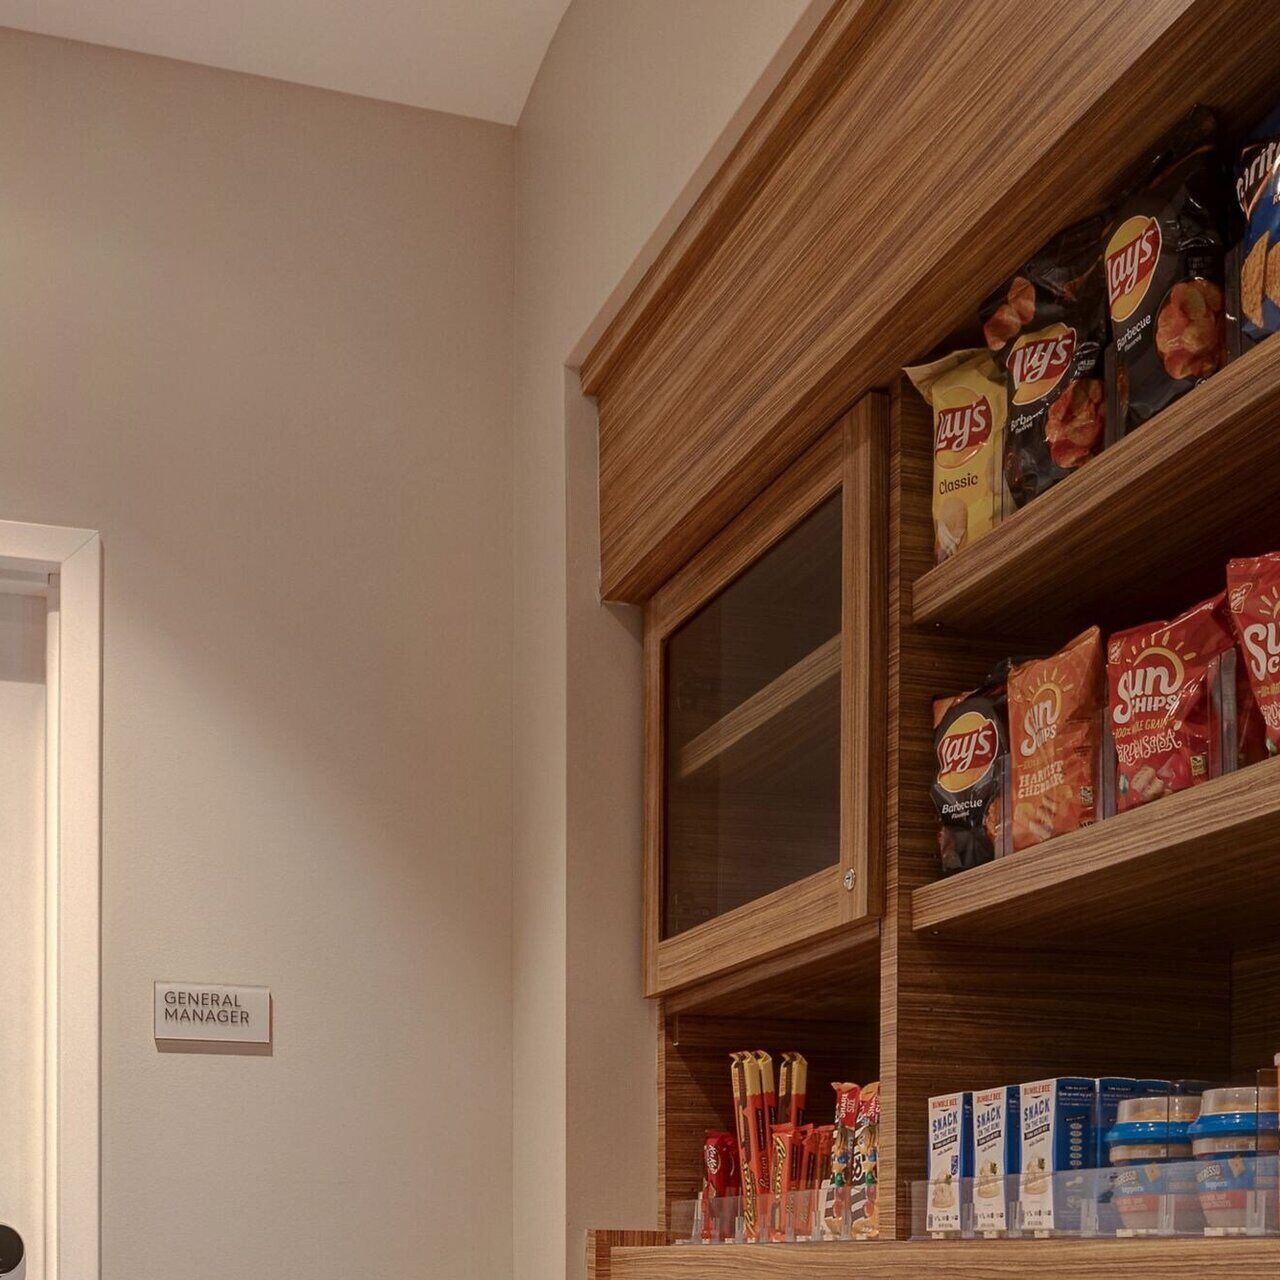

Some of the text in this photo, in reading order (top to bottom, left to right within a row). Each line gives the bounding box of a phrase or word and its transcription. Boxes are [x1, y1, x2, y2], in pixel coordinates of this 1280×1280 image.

[1108, 228, 1158, 303] Lay's
[1116, 315, 1151, 351] Barbecue
[937, 402, 987, 450] Lay's
[939, 473, 979, 496] Classic
[1113, 666, 1183, 724] Sun
[940, 727, 993, 774] Lay's
[942, 798, 983, 815] Barbecue
[164, 991, 241, 1007] GENERAL
[164, 1008, 249, 1024] MANAGER
[932, 1111, 958, 1133] SNACK
[977, 1105, 1001, 1128] SNACK
[1024, 1099, 1050, 1122] SNACK
